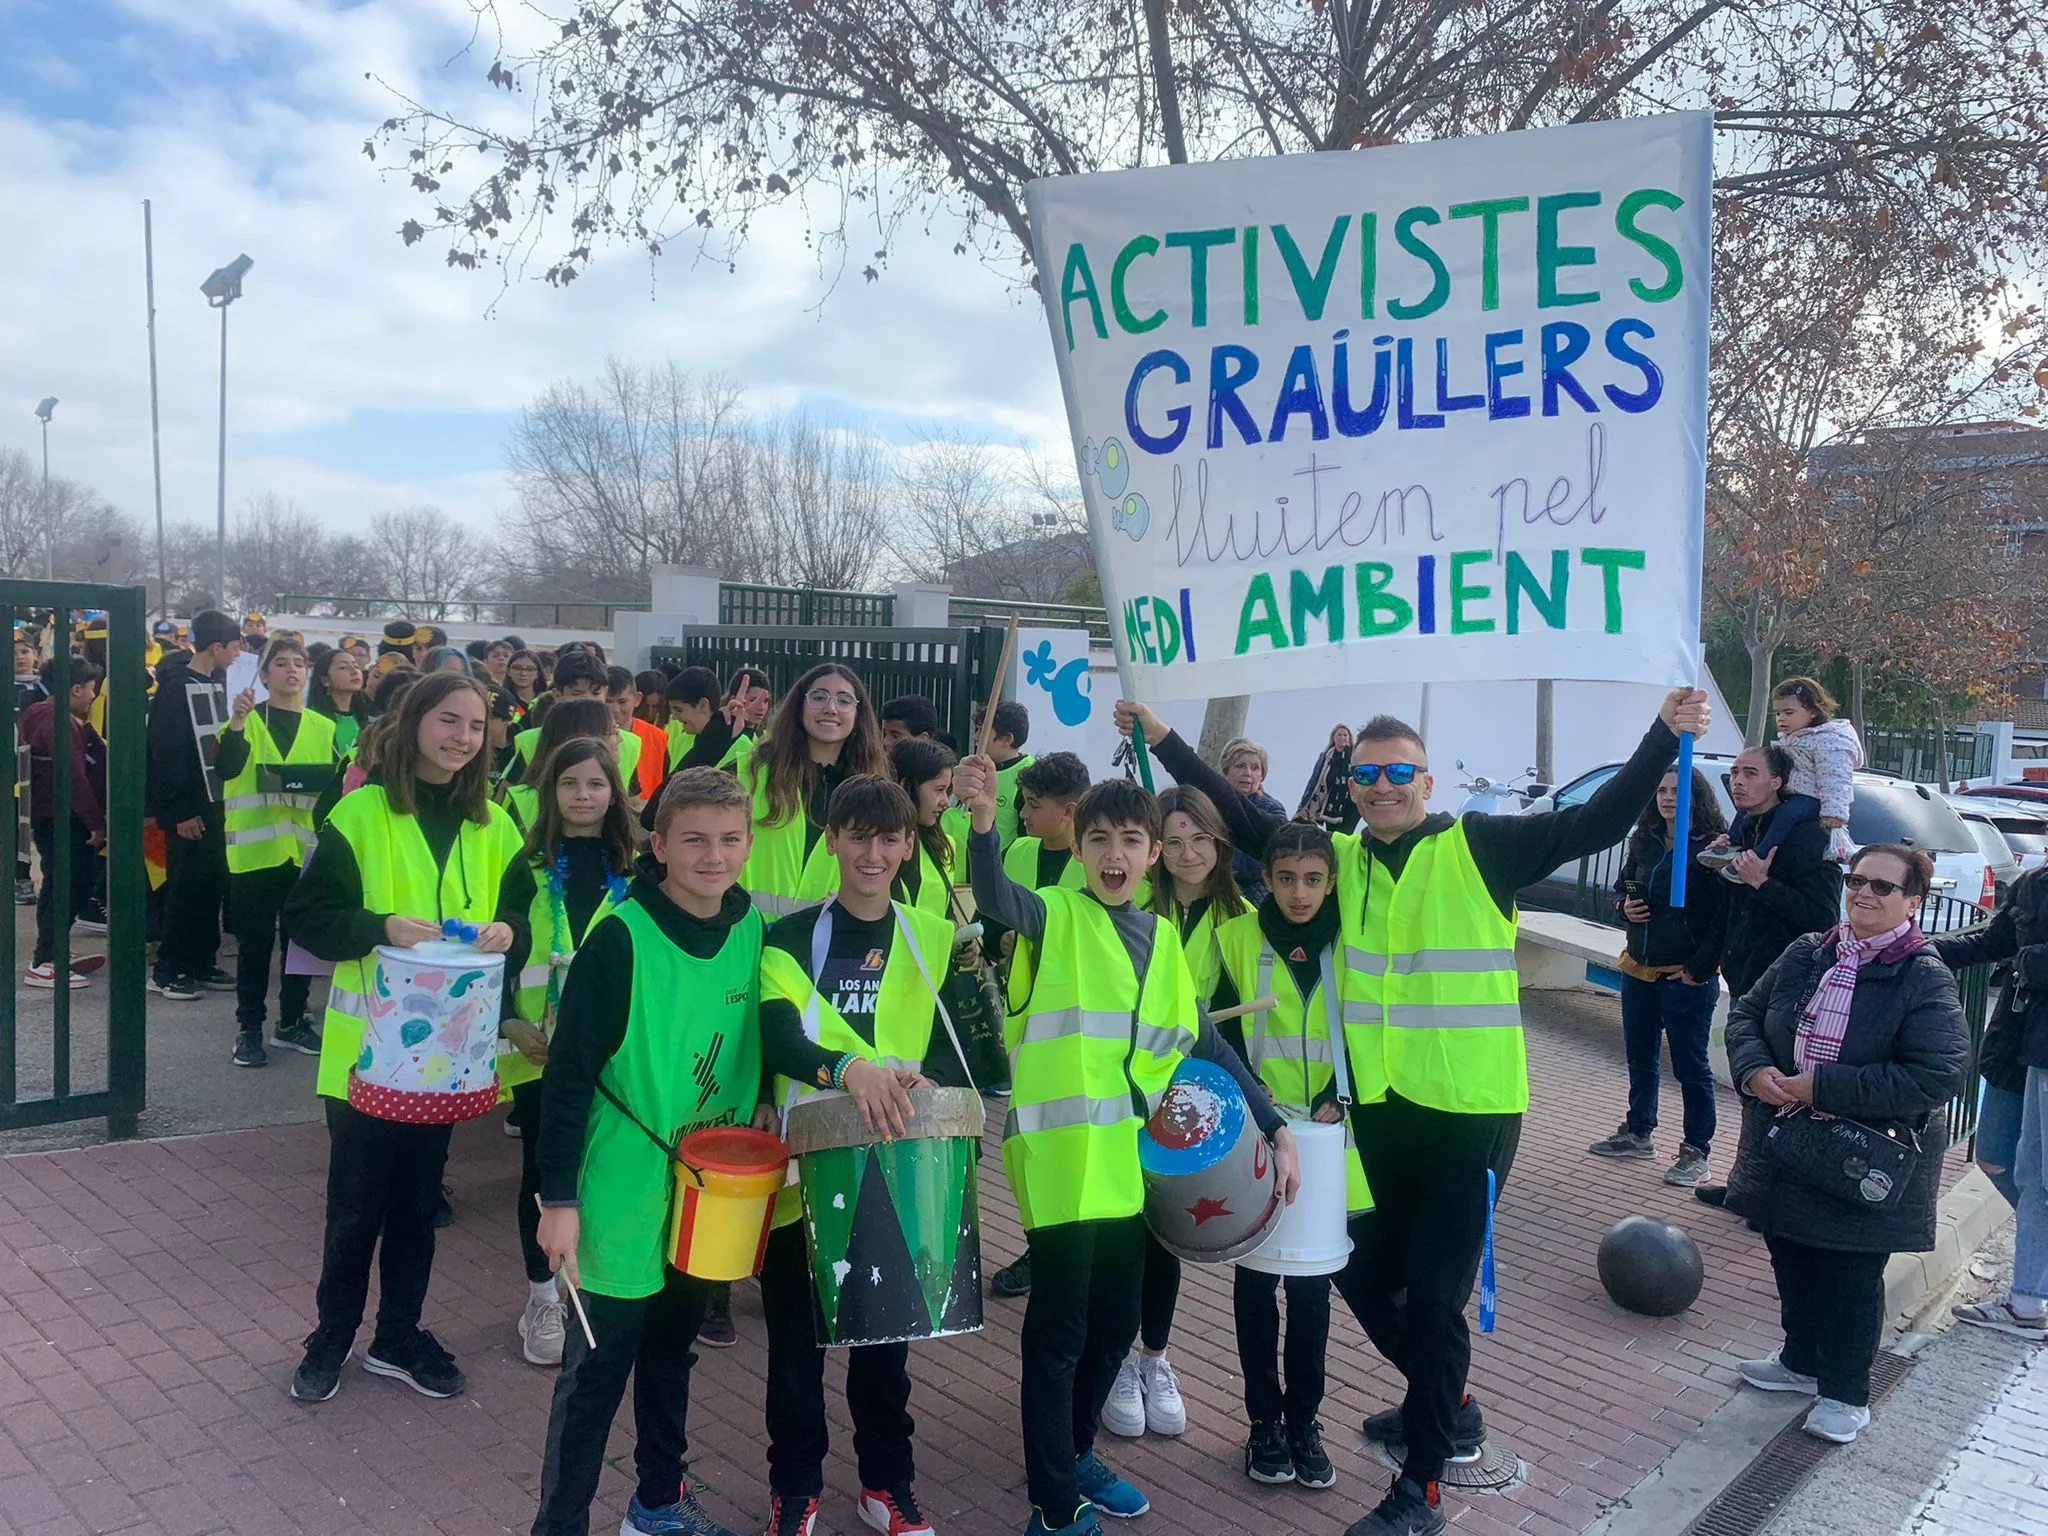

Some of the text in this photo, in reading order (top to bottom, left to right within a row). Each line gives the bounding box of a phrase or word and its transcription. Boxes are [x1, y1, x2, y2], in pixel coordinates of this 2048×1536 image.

[1061, 188, 1685, 353] ACTIVISTES
[1124, 317, 1664, 455] GRAÜLLERS
[1165, 421, 1607, 567] lluitem pel
[1121, 547, 1646, 666] MEDI AMBIENT
[839, 979, 860, 991] LOS
